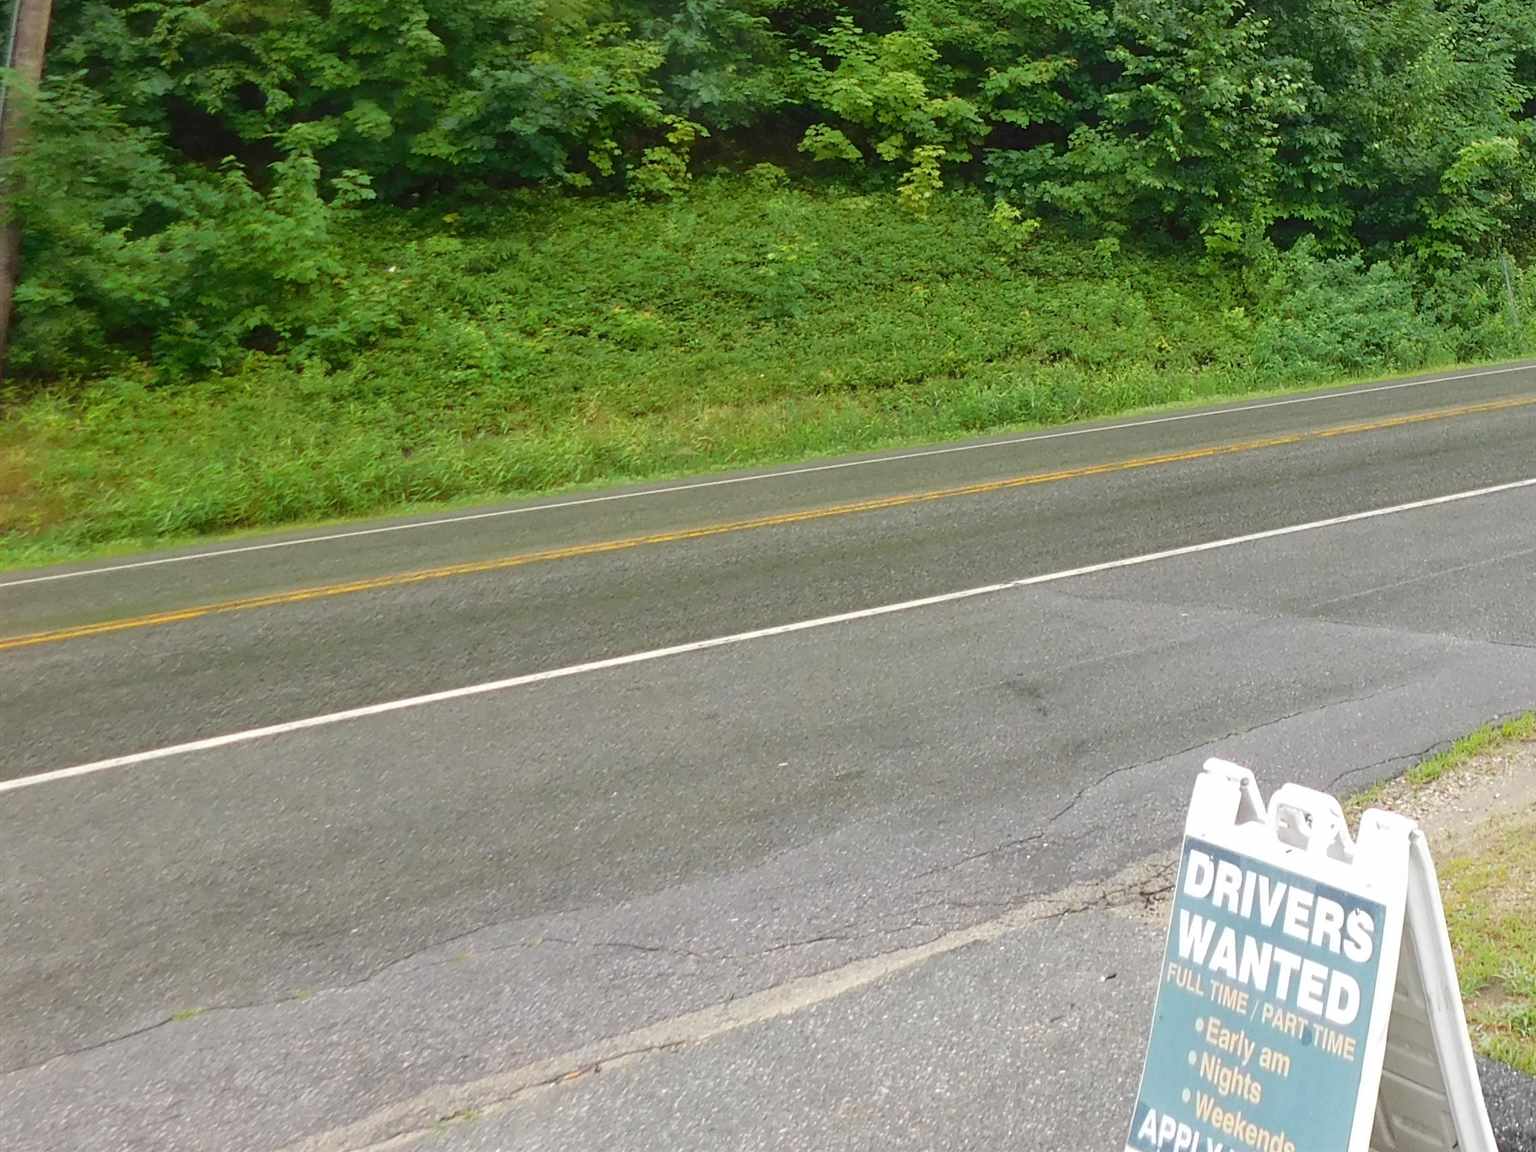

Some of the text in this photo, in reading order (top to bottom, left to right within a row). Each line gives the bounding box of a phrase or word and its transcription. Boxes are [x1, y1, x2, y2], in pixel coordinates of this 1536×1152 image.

[1183, 849, 1376, 963] DRIVERS
[1179, 909, 1361, 1026] WANTED
[1167, 962, 1205, 997] FULL
[1210, 979, 1249, 1016] TIME
[1261, 1003, 1309, 1041] PART
[1312, 1023, 1357, 1061] TIME
[1205, 1015, 1291, 1078] Early am
[1199, 1051, 1262, 1104] Nights
[1195, 1090, 1296, 1152] Weekends
